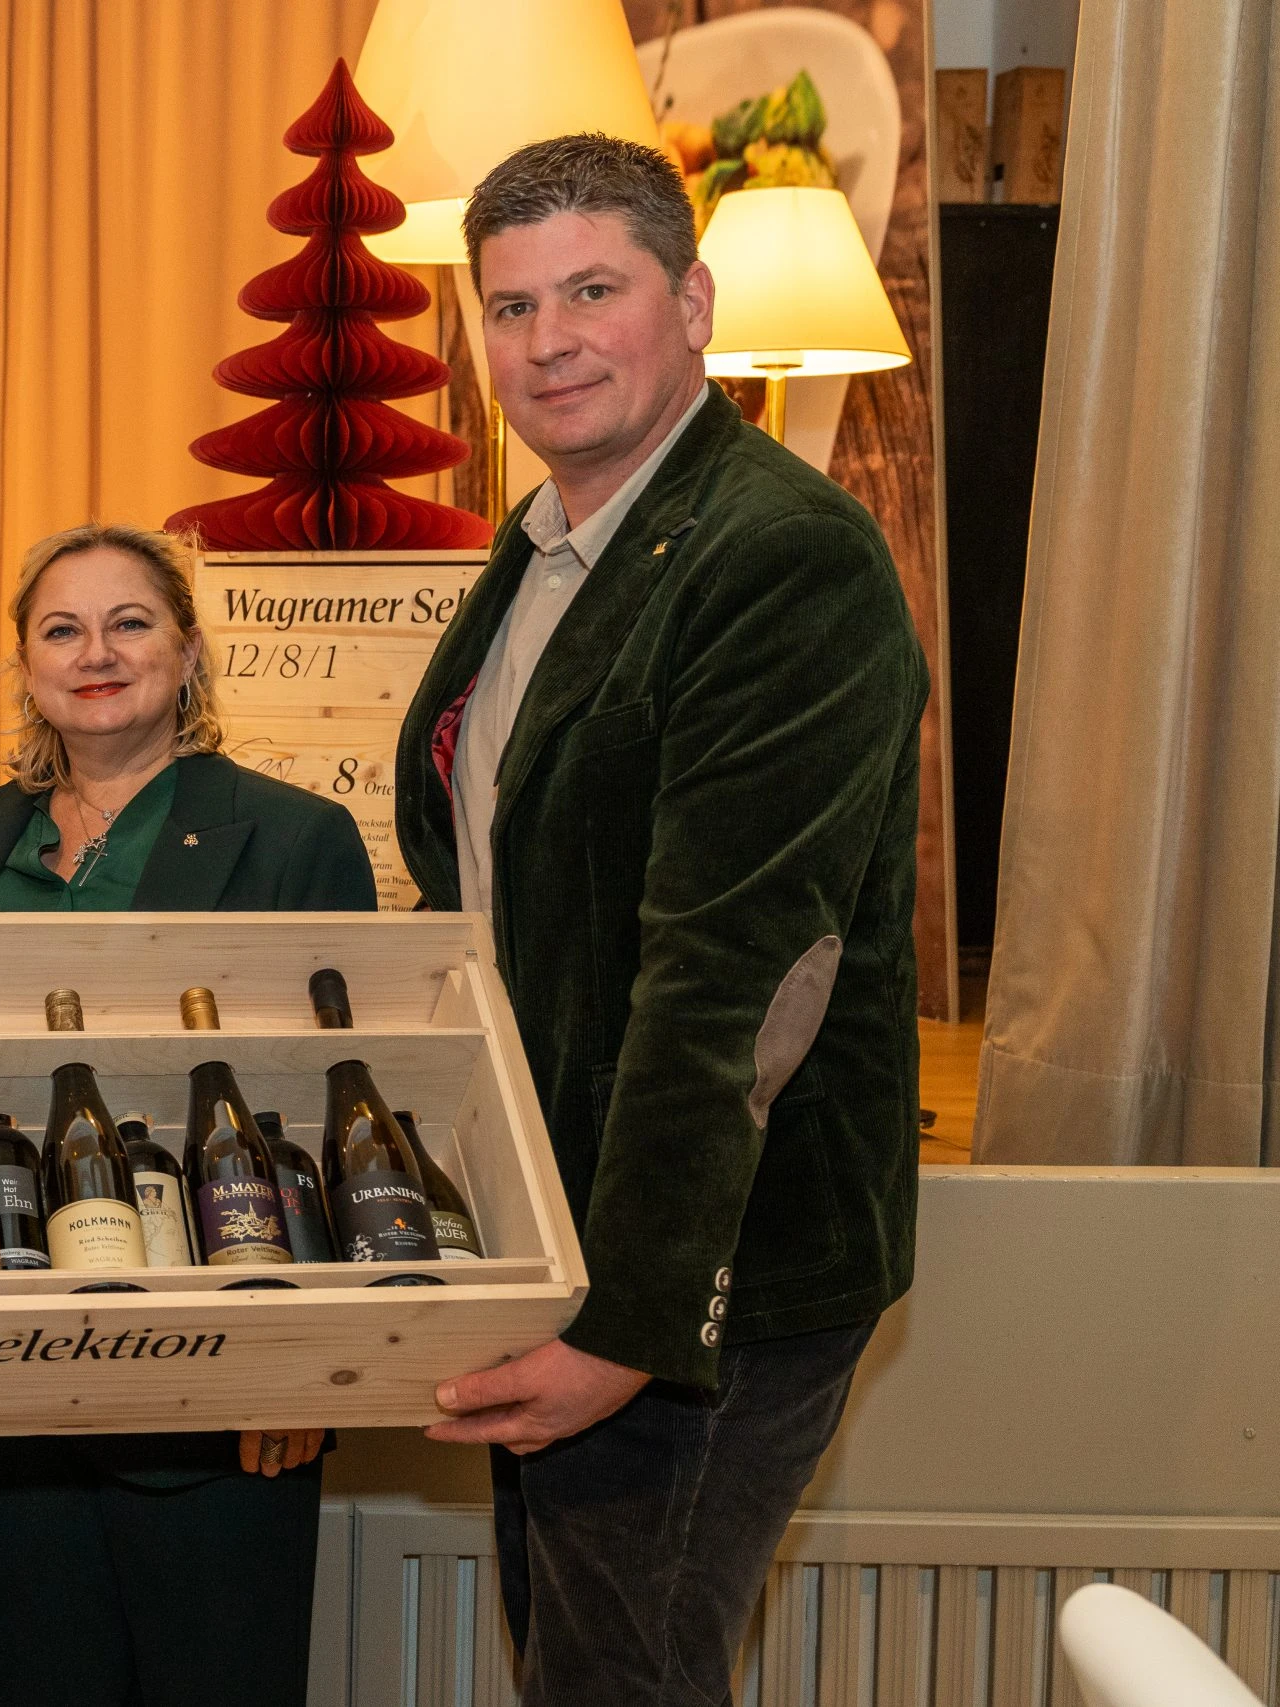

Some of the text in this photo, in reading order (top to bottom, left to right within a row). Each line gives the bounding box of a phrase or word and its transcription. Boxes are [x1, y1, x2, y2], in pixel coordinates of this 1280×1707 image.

[224, 588, 466, 630] Wagramer Sel
[223, 643, 338, 679] 12/8/1
[332, 757, 395, 796] 8 Orte
[357, 819, 393, 829] tockstall
[212, 1186, 229, 1198] M.
[231, 1182, 276, 1199] MAYER
[4, 1195, 33, 1210] Ehn
[69, 1216, 131, 1232] KOLKMANN
[431, 1216, 463, 1230] Stefan
[434, 1228, 469, 1242] AUER
